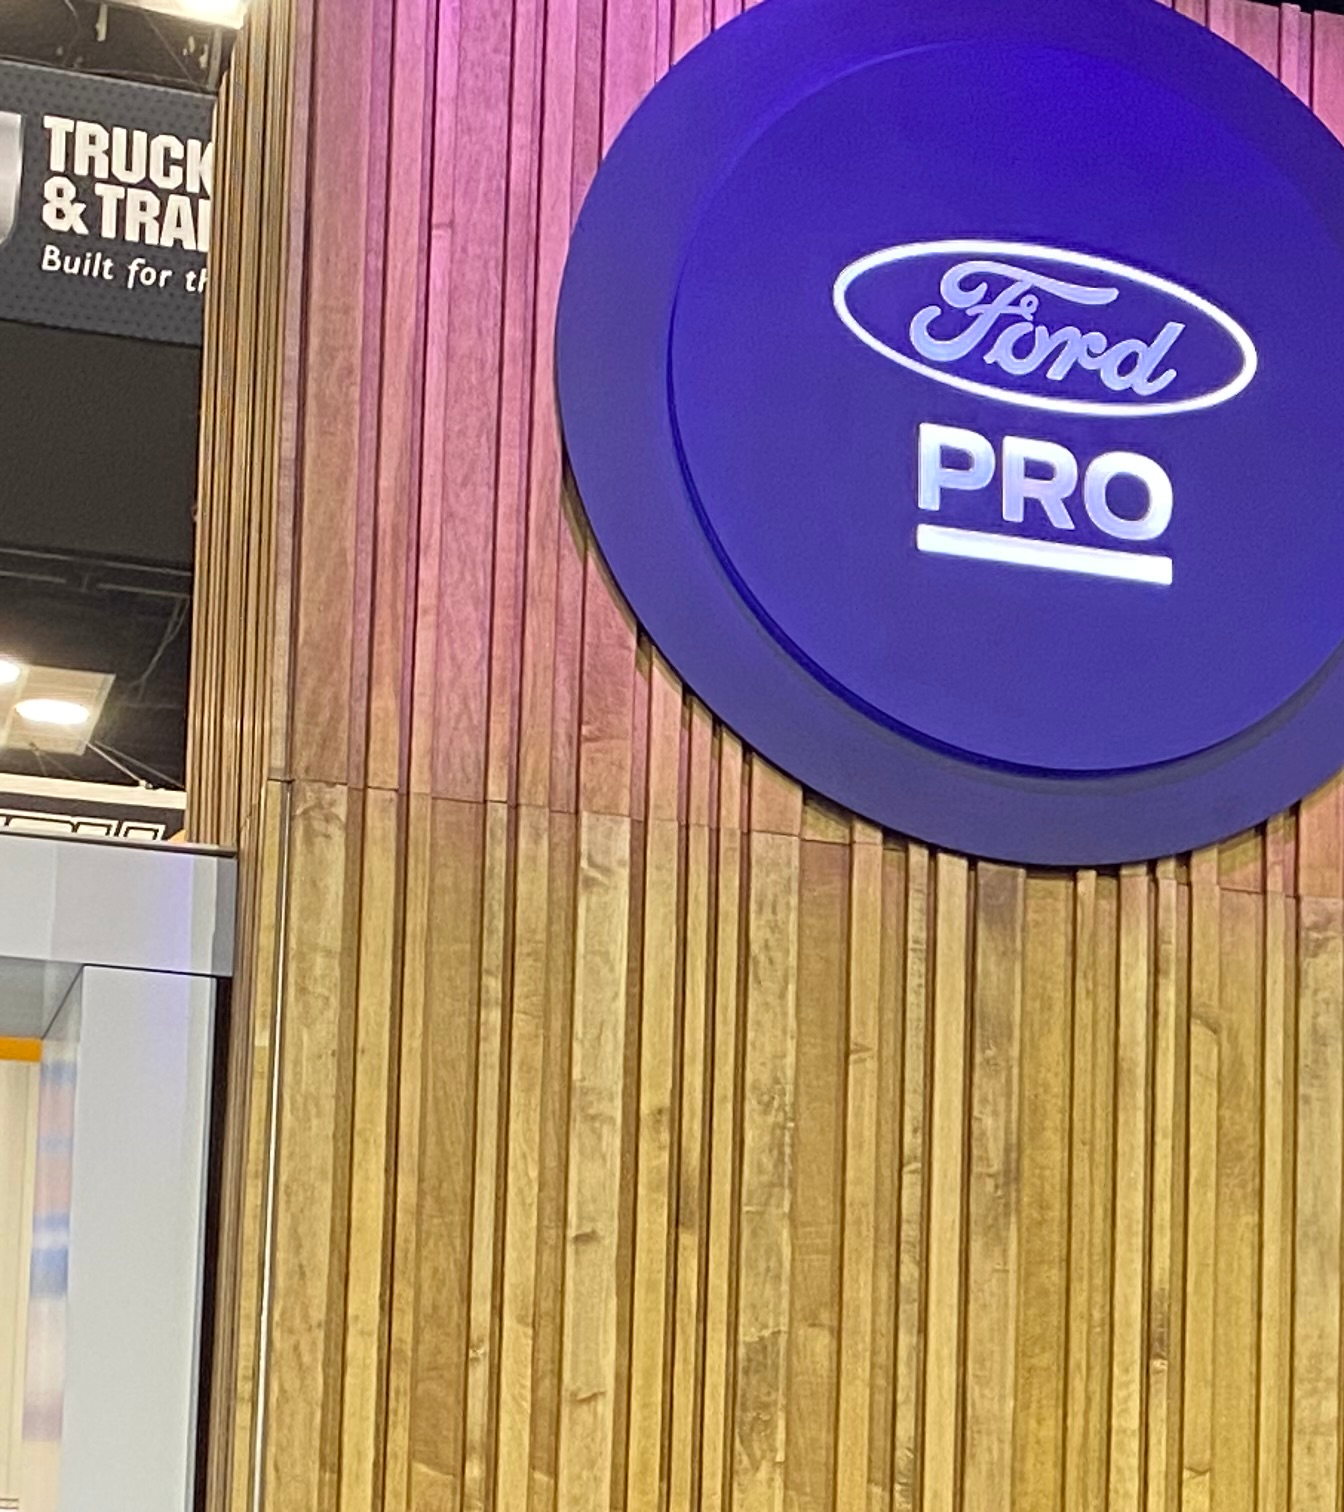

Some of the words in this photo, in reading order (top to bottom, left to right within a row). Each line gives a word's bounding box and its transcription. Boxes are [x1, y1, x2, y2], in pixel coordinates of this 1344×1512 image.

[43, 115, 213, 196] TRUCK
[42, 175, 89, 235] &
[41, 244, 114, 280] Built
[127, 257, 173, 289] for
[910, 260, 1185, 395] Ford
[918, 422, 1173, 541] PRO
